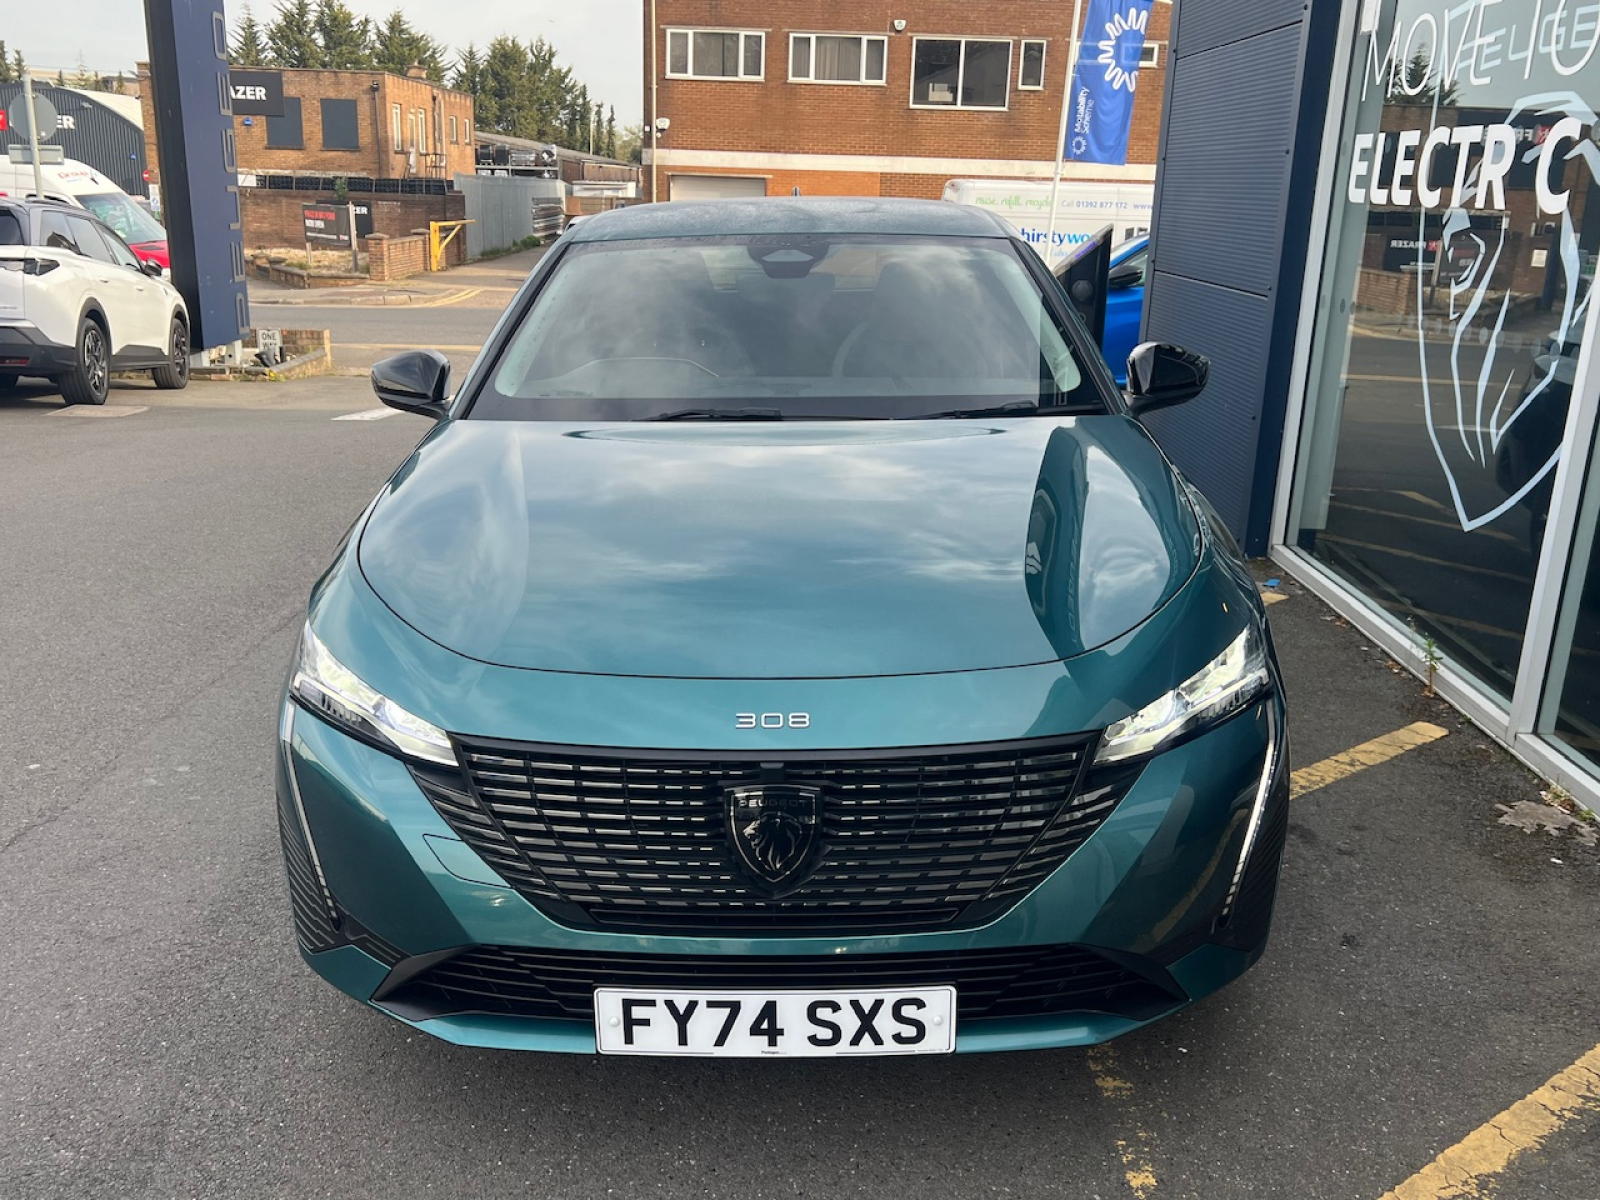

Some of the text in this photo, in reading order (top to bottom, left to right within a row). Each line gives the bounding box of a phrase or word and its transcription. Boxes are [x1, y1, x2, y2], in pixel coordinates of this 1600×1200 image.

[1361, 0, 1500, 101] MOVE
[1074, 85, 1090, 134] Motability
[1080, 99, 1095, 135] Scheme
[1061, 200, 1075, 208] Call
[1076, 200, 1098, 209] 01392
[1100, 201, 1113, 209] 877
[1115, 202, 1128, 210] 172
[261, 332, 277, 341] ONE
[735, 712, 811, 729] 308
[621, 998, 926, 1047] FY74 SXS
